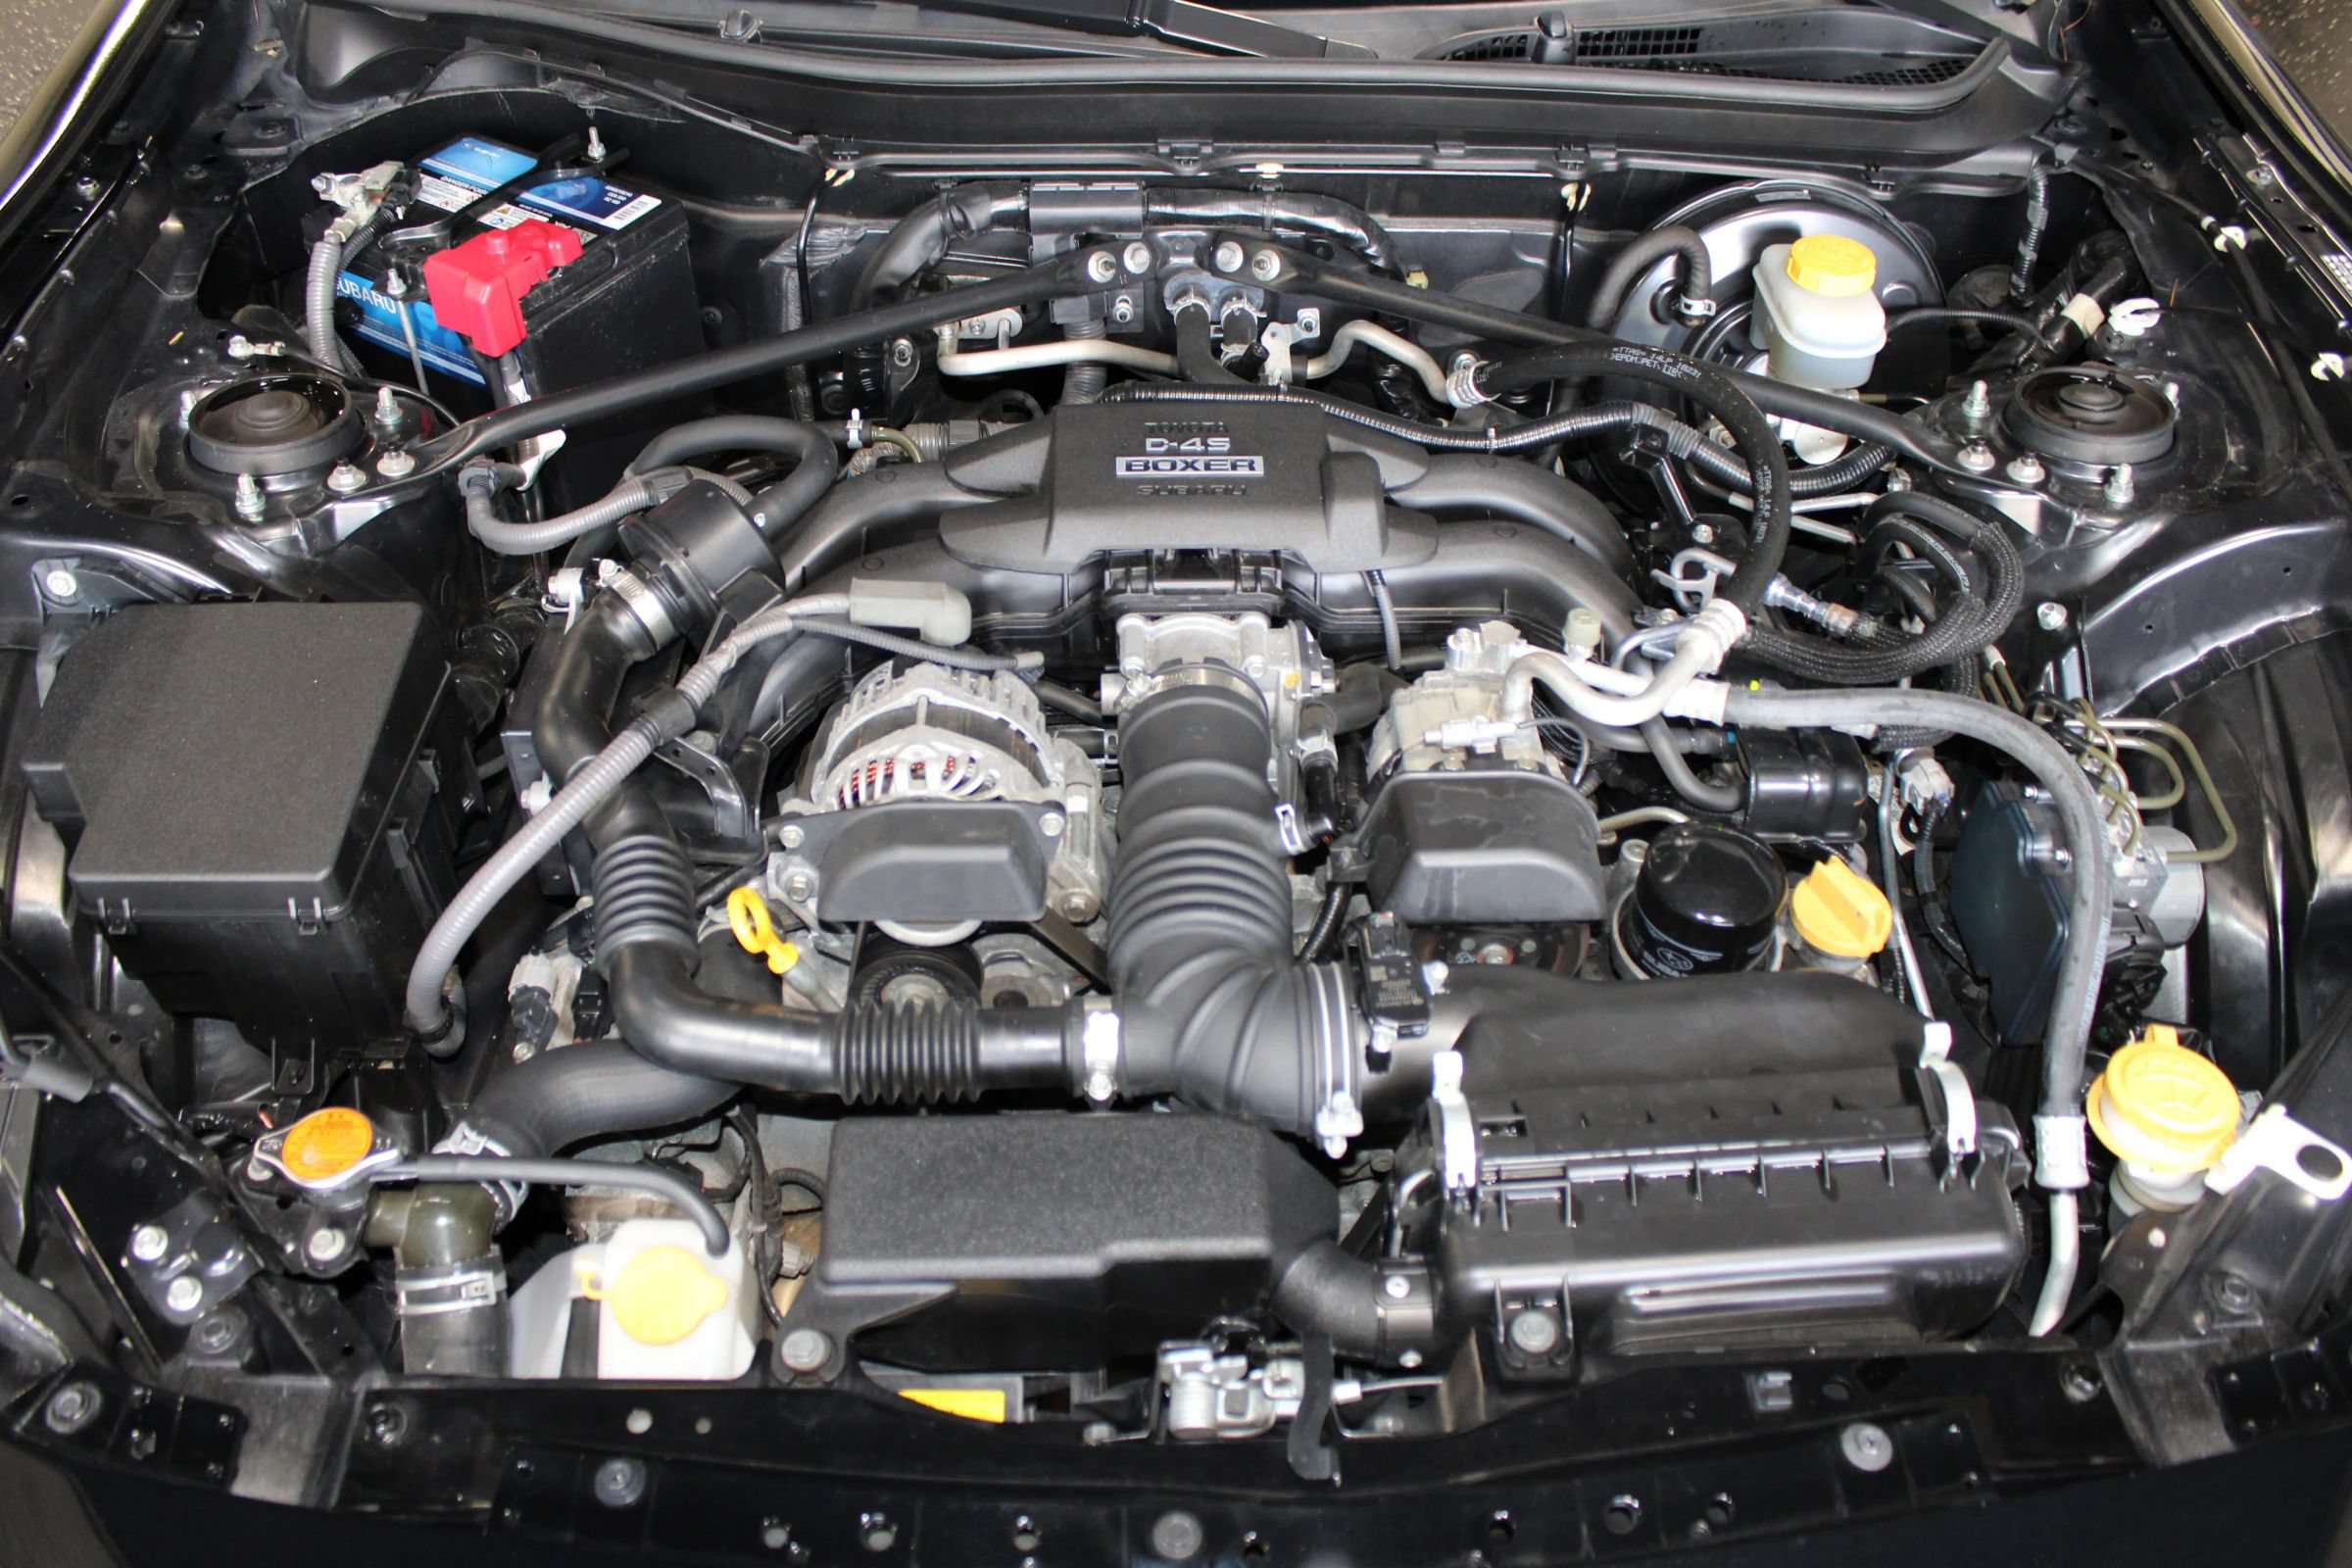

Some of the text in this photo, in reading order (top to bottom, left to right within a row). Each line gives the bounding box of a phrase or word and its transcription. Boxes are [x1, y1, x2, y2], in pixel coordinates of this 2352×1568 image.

[1144, 421, 1230, 433] TOYOTA
[1145, 437, 1231, 454] D-4S
[1125, 458, 1256, 471] BOXER
[1137, 484, 1247, 496] SUBARU
